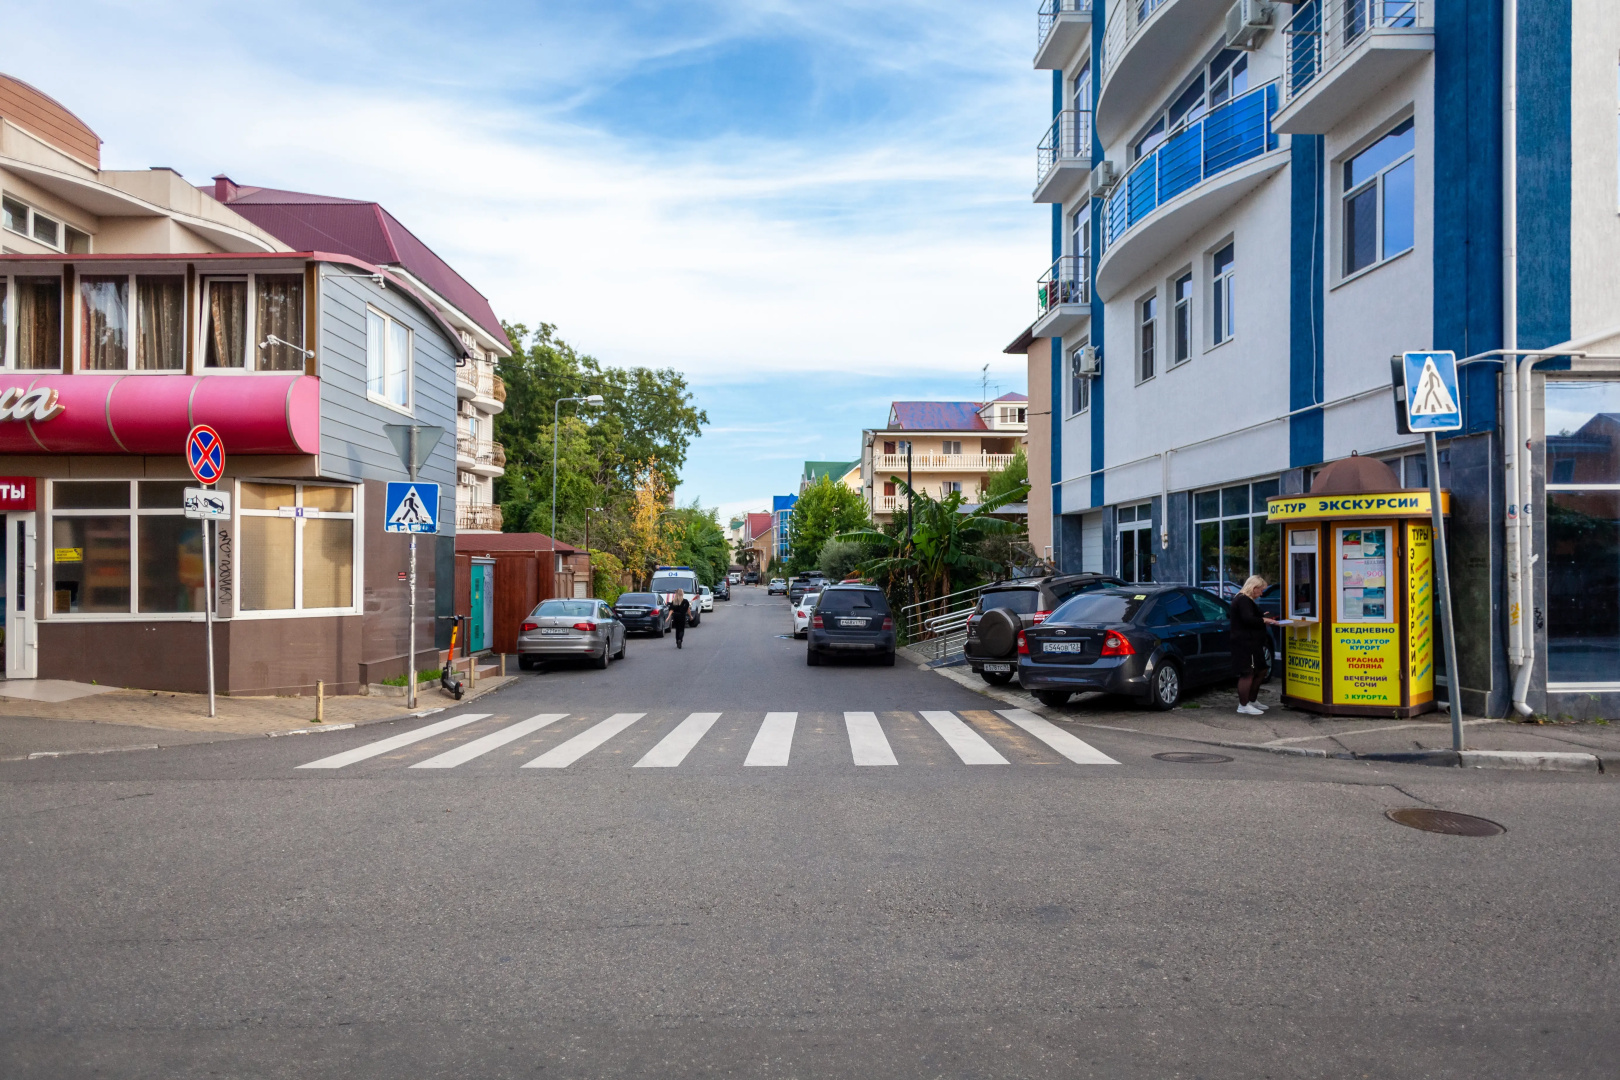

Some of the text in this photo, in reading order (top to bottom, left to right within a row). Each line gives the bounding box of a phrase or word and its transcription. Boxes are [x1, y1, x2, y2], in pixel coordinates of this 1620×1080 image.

[0, 484, 25, 499] ТЫ
[1319, 498, 1418, 511] ЭКСКУРСИИ
[1412, 528, 1428, 540] ТУРЫ
[1288, 655, 1320, 670] ЭКСКУРСИИ
